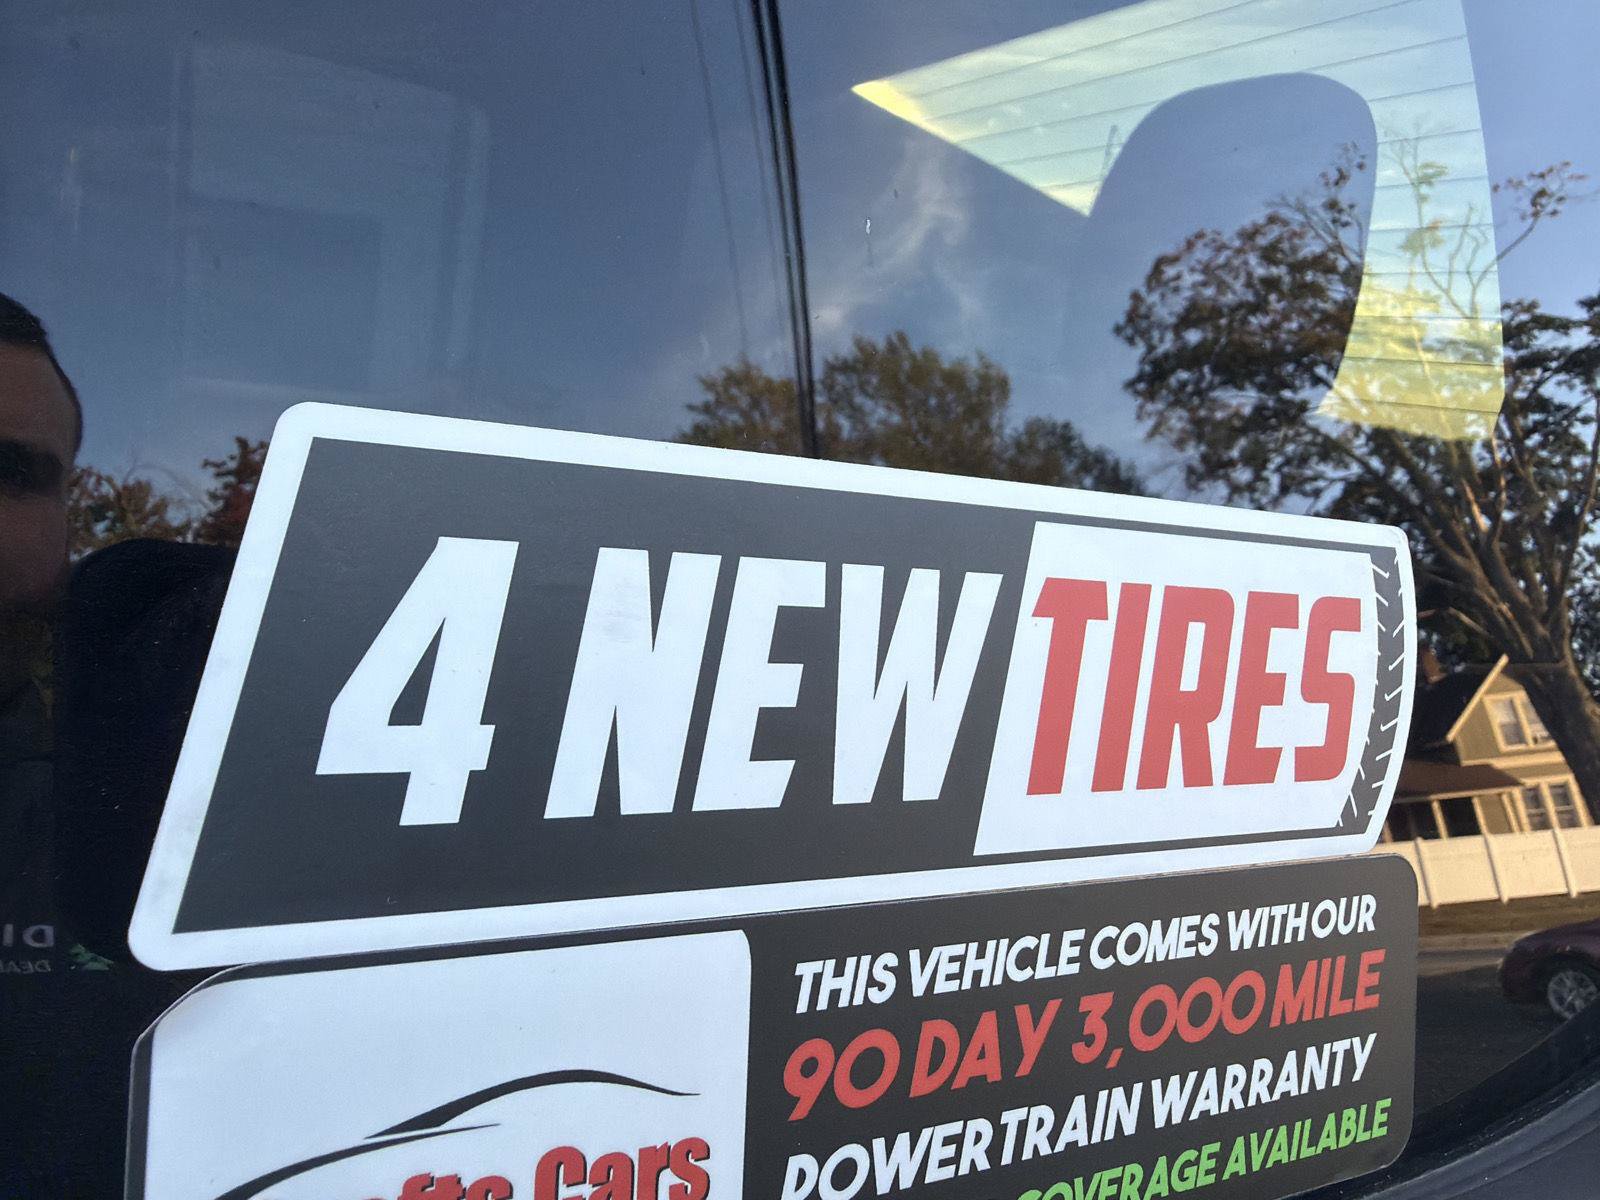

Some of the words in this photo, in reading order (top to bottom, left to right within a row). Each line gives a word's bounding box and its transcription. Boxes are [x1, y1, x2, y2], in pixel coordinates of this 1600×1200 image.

[315, 536, 520, 826] 4
[543, 546, 1004, 820] NEW
[1026, 577, 1361, 796] TIRES
[794, 952, 898, 1014] THIS
[908, 928, 1086, 998] VEHICLE
[1089, 912, 1221, 970] COMES
[1227, 901, 1310, 952] WITH
[1310, 893, 1377, 939] OUR
[783, 1029, 900, 1121] 90
[911, 999, 1062, 1097] DAY
[1071, 971, 1267, 1069] 3,000
[1270, 949, 1385, 1028] MILE
[1150, 1032, 1378, 1129] WARRANTY
[535, 1136, 710, 1200] Cars
[1018, 1141, 1221, 1200] VERAGE
[1221, 1098, 1393, 1181] AVAILABLE
